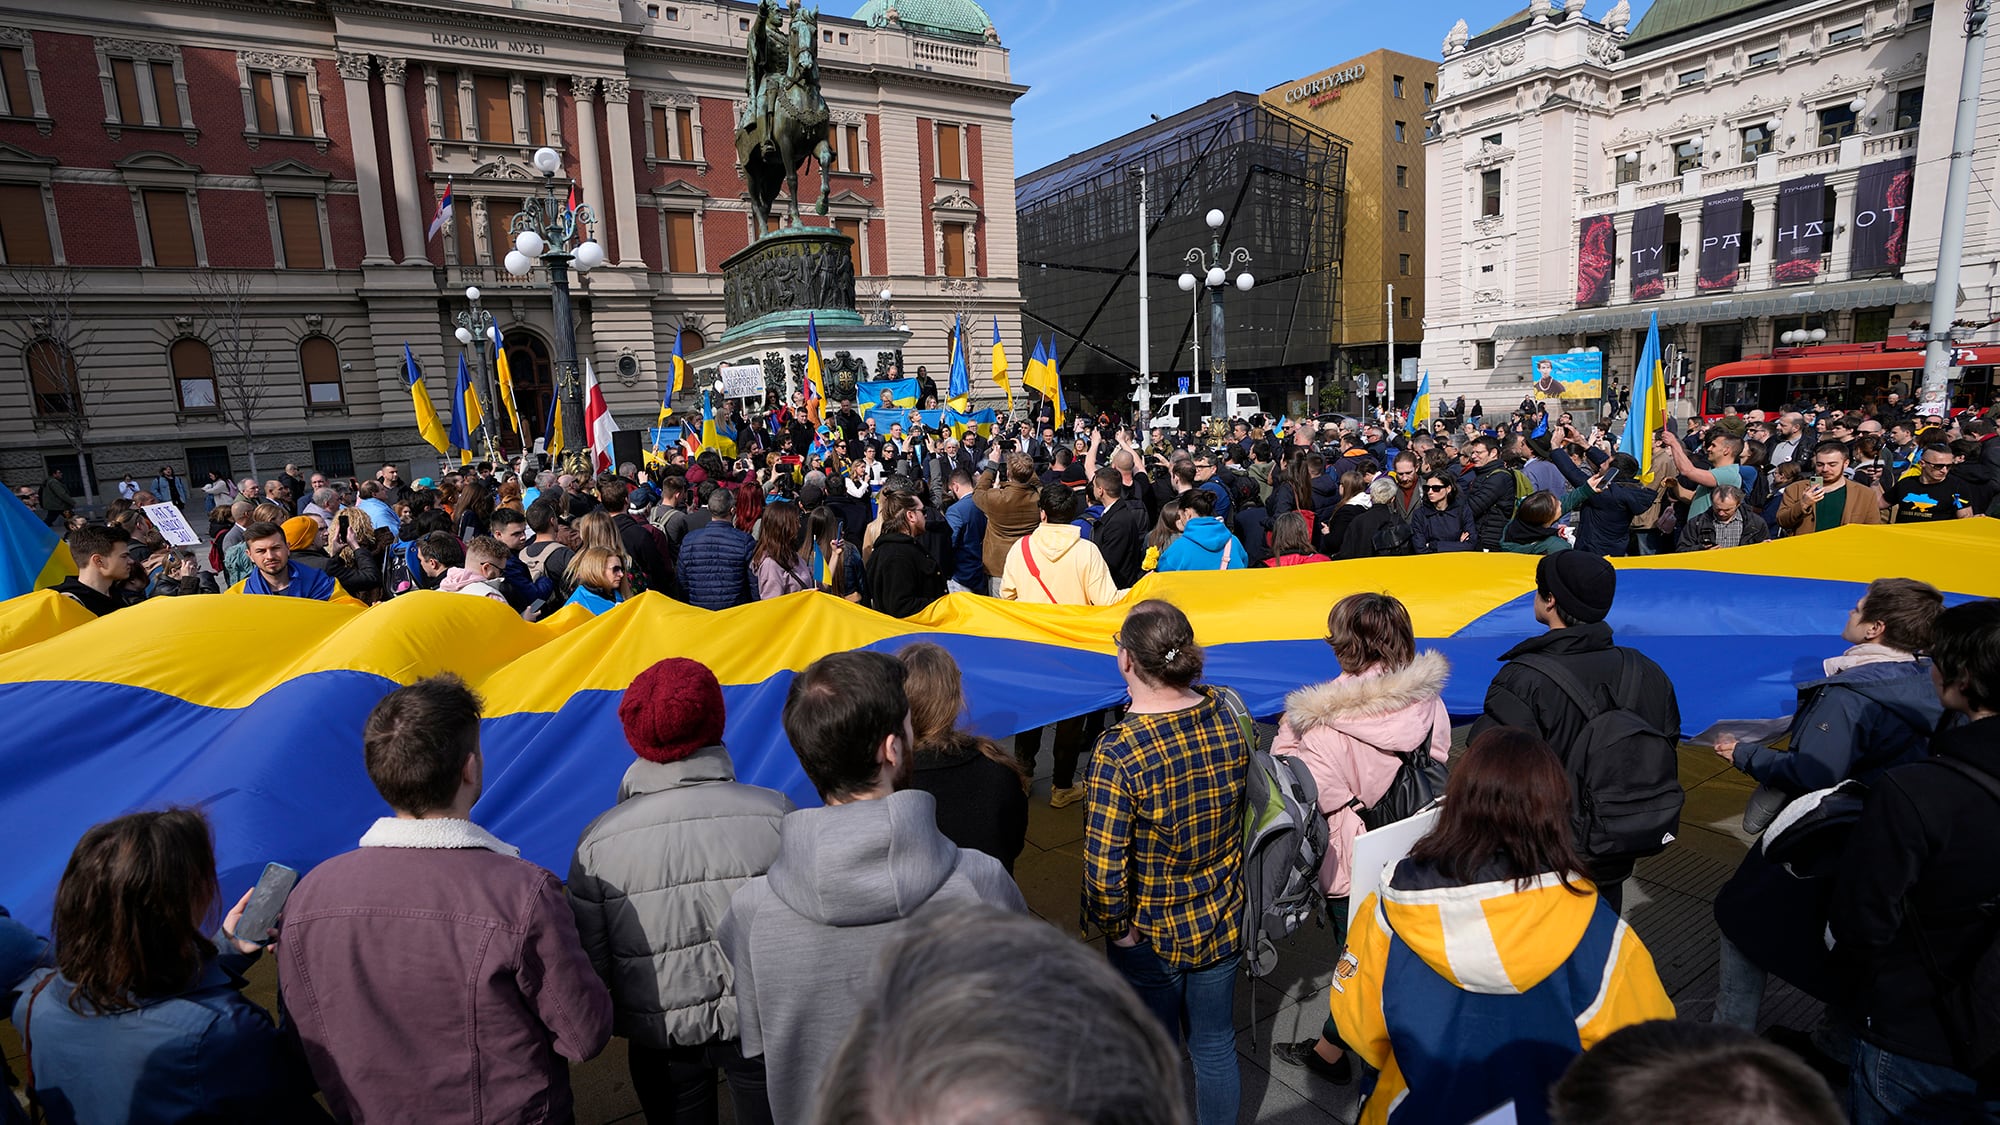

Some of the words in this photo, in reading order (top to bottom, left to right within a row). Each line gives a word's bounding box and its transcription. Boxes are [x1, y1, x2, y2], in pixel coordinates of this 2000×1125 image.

[431, 32, 499, 50] НАРОДНИ
[1285, 64, 1365, 102] COURTYARD
[727, 377, 758, 387] SUPPORTS
